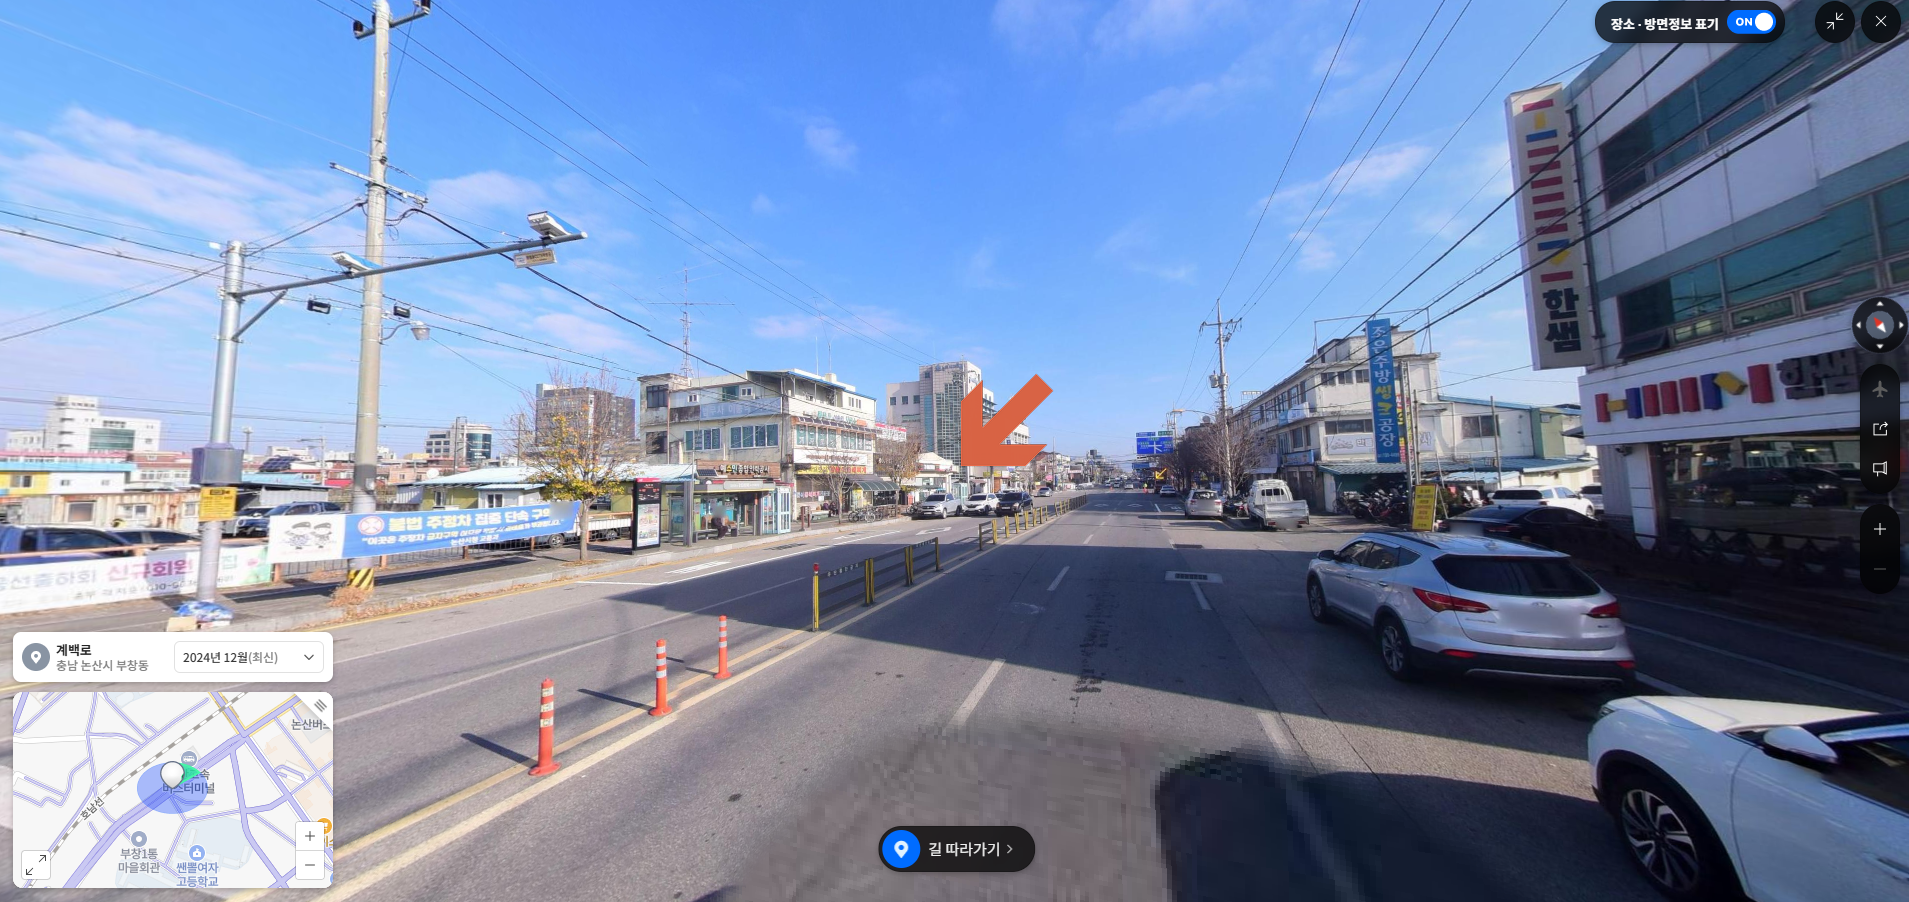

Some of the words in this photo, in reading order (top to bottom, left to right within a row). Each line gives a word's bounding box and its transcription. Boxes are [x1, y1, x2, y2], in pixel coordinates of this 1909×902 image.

[1543, 288, 1581, 353] 한샘
[389, 516, 422, 532] 불법
[426, 513, 471, 529] 주정차
[475, 511, 501, 526] 집중
[505, 509, 529, 522] 단속
[107, 558, 193, 582] 신규회원
